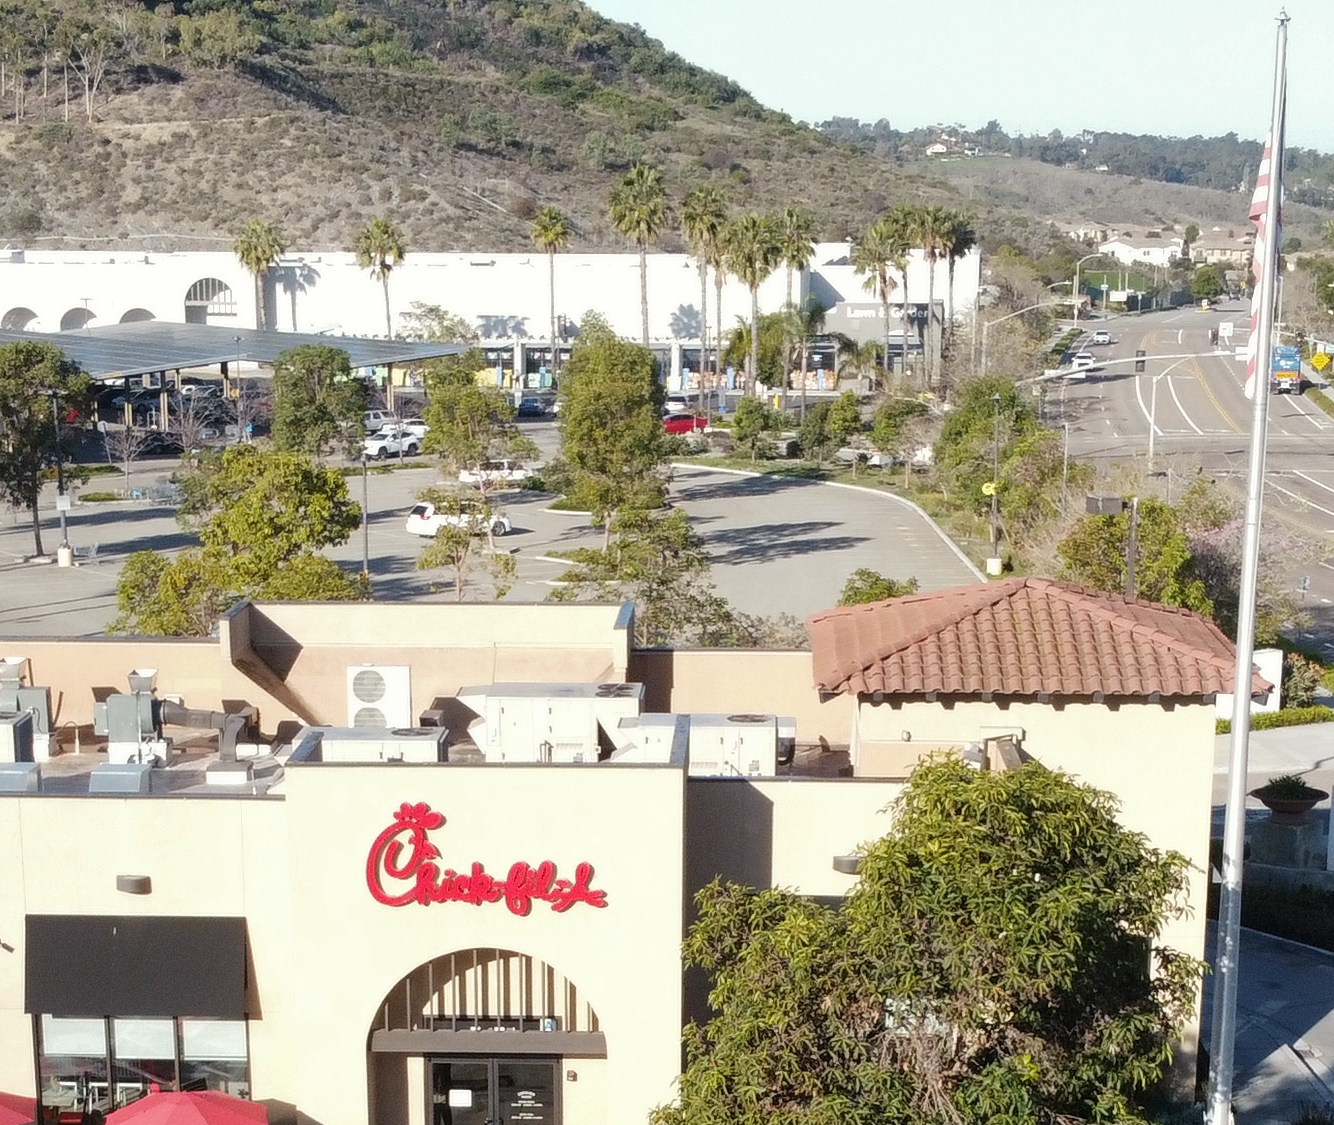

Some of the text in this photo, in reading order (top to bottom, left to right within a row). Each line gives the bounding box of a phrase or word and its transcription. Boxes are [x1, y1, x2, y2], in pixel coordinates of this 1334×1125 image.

[847, 306, 930, 319] Lawn & Gaden
[365, 801, 609, 917] Chick-fil-A
